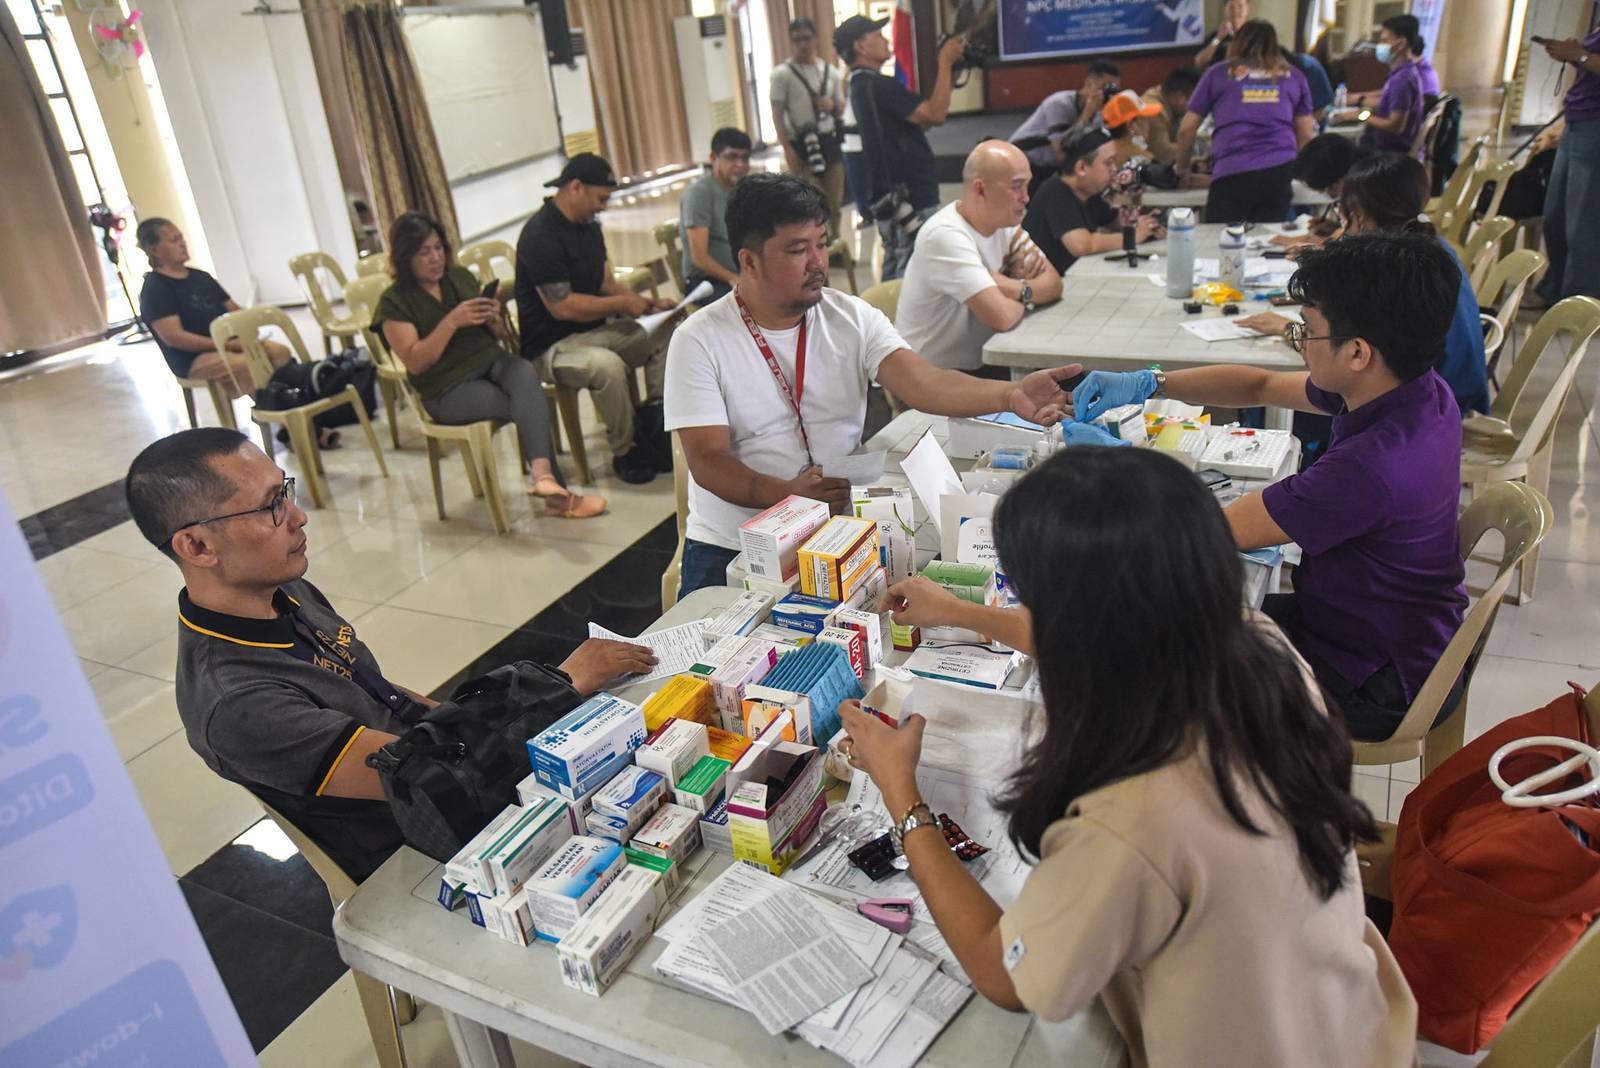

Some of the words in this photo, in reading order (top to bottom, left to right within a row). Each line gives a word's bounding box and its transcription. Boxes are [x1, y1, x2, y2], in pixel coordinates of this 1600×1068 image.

[972, 543, 995, 551] Profile
[313, 654, 353, 681] NET25
[540, 842, 580, 880] VALSARTAN
